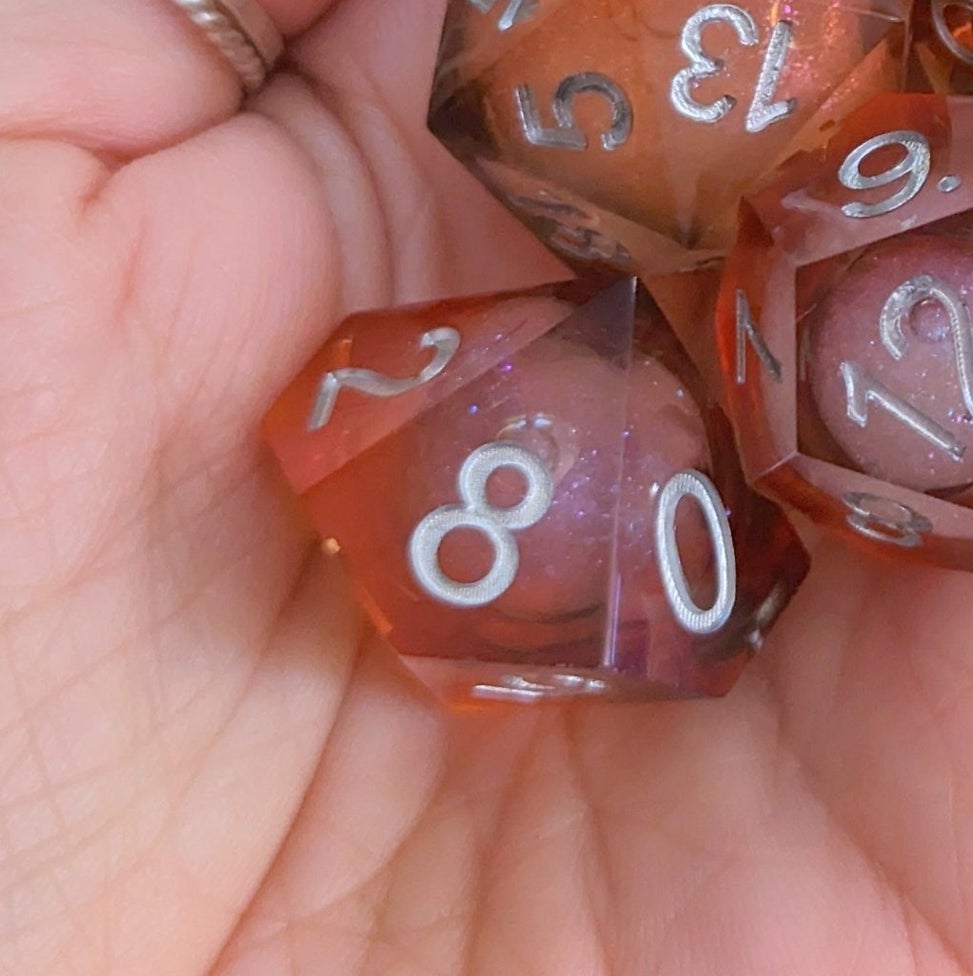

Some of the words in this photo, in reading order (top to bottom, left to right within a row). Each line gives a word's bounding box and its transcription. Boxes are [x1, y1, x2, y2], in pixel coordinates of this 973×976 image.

[514, 71, 634, 151] 5
[670, 3, 797, 133] 13
[308, 326, 461, 431] 2
[409, 441, 553, 606] 8
[656, 469, 736, 633] 0
